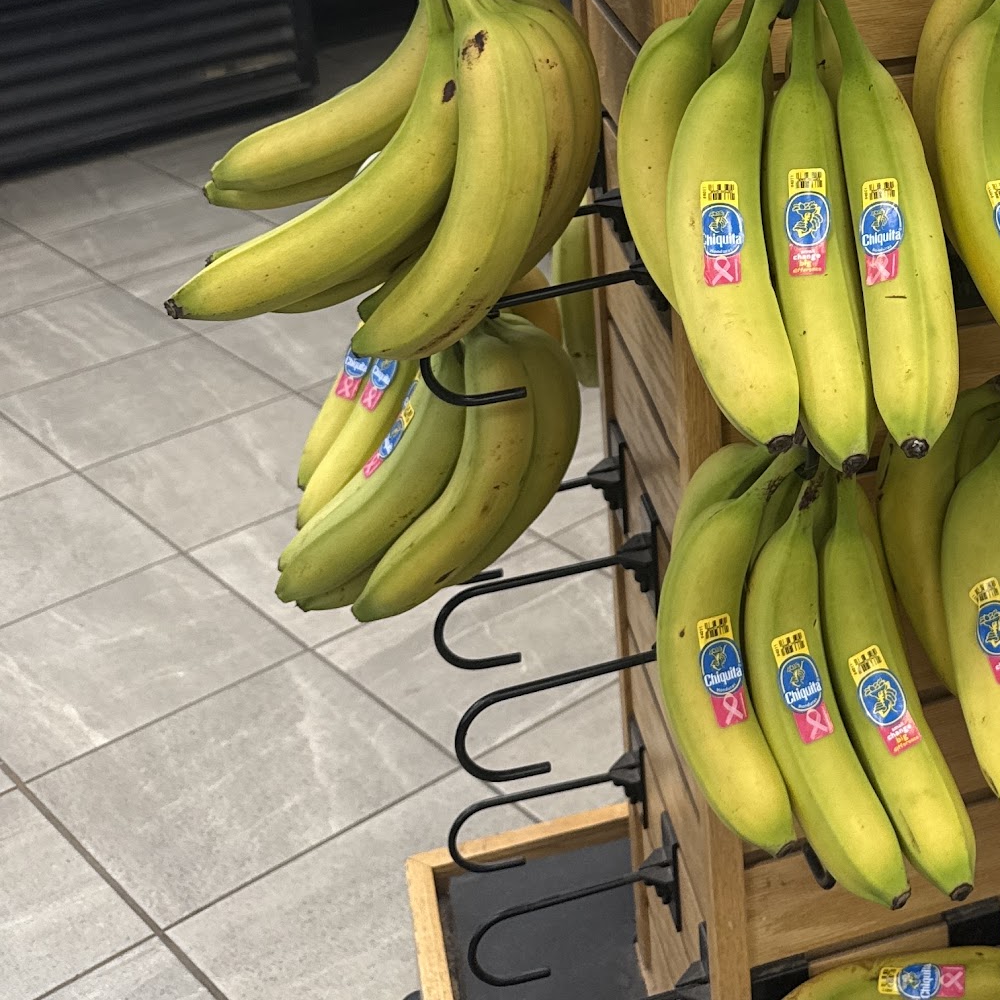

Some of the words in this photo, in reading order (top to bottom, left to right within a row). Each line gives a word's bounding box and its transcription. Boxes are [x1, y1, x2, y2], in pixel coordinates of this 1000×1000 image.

[703, 232, 742, 248] Chiquita
[862, 229, 902, 247] Chiquita
[703, 666, 742, 688] Chiquita
[784, 681, 822, 706] Chiquita
[920, 963, 932, 999] Chiquita
